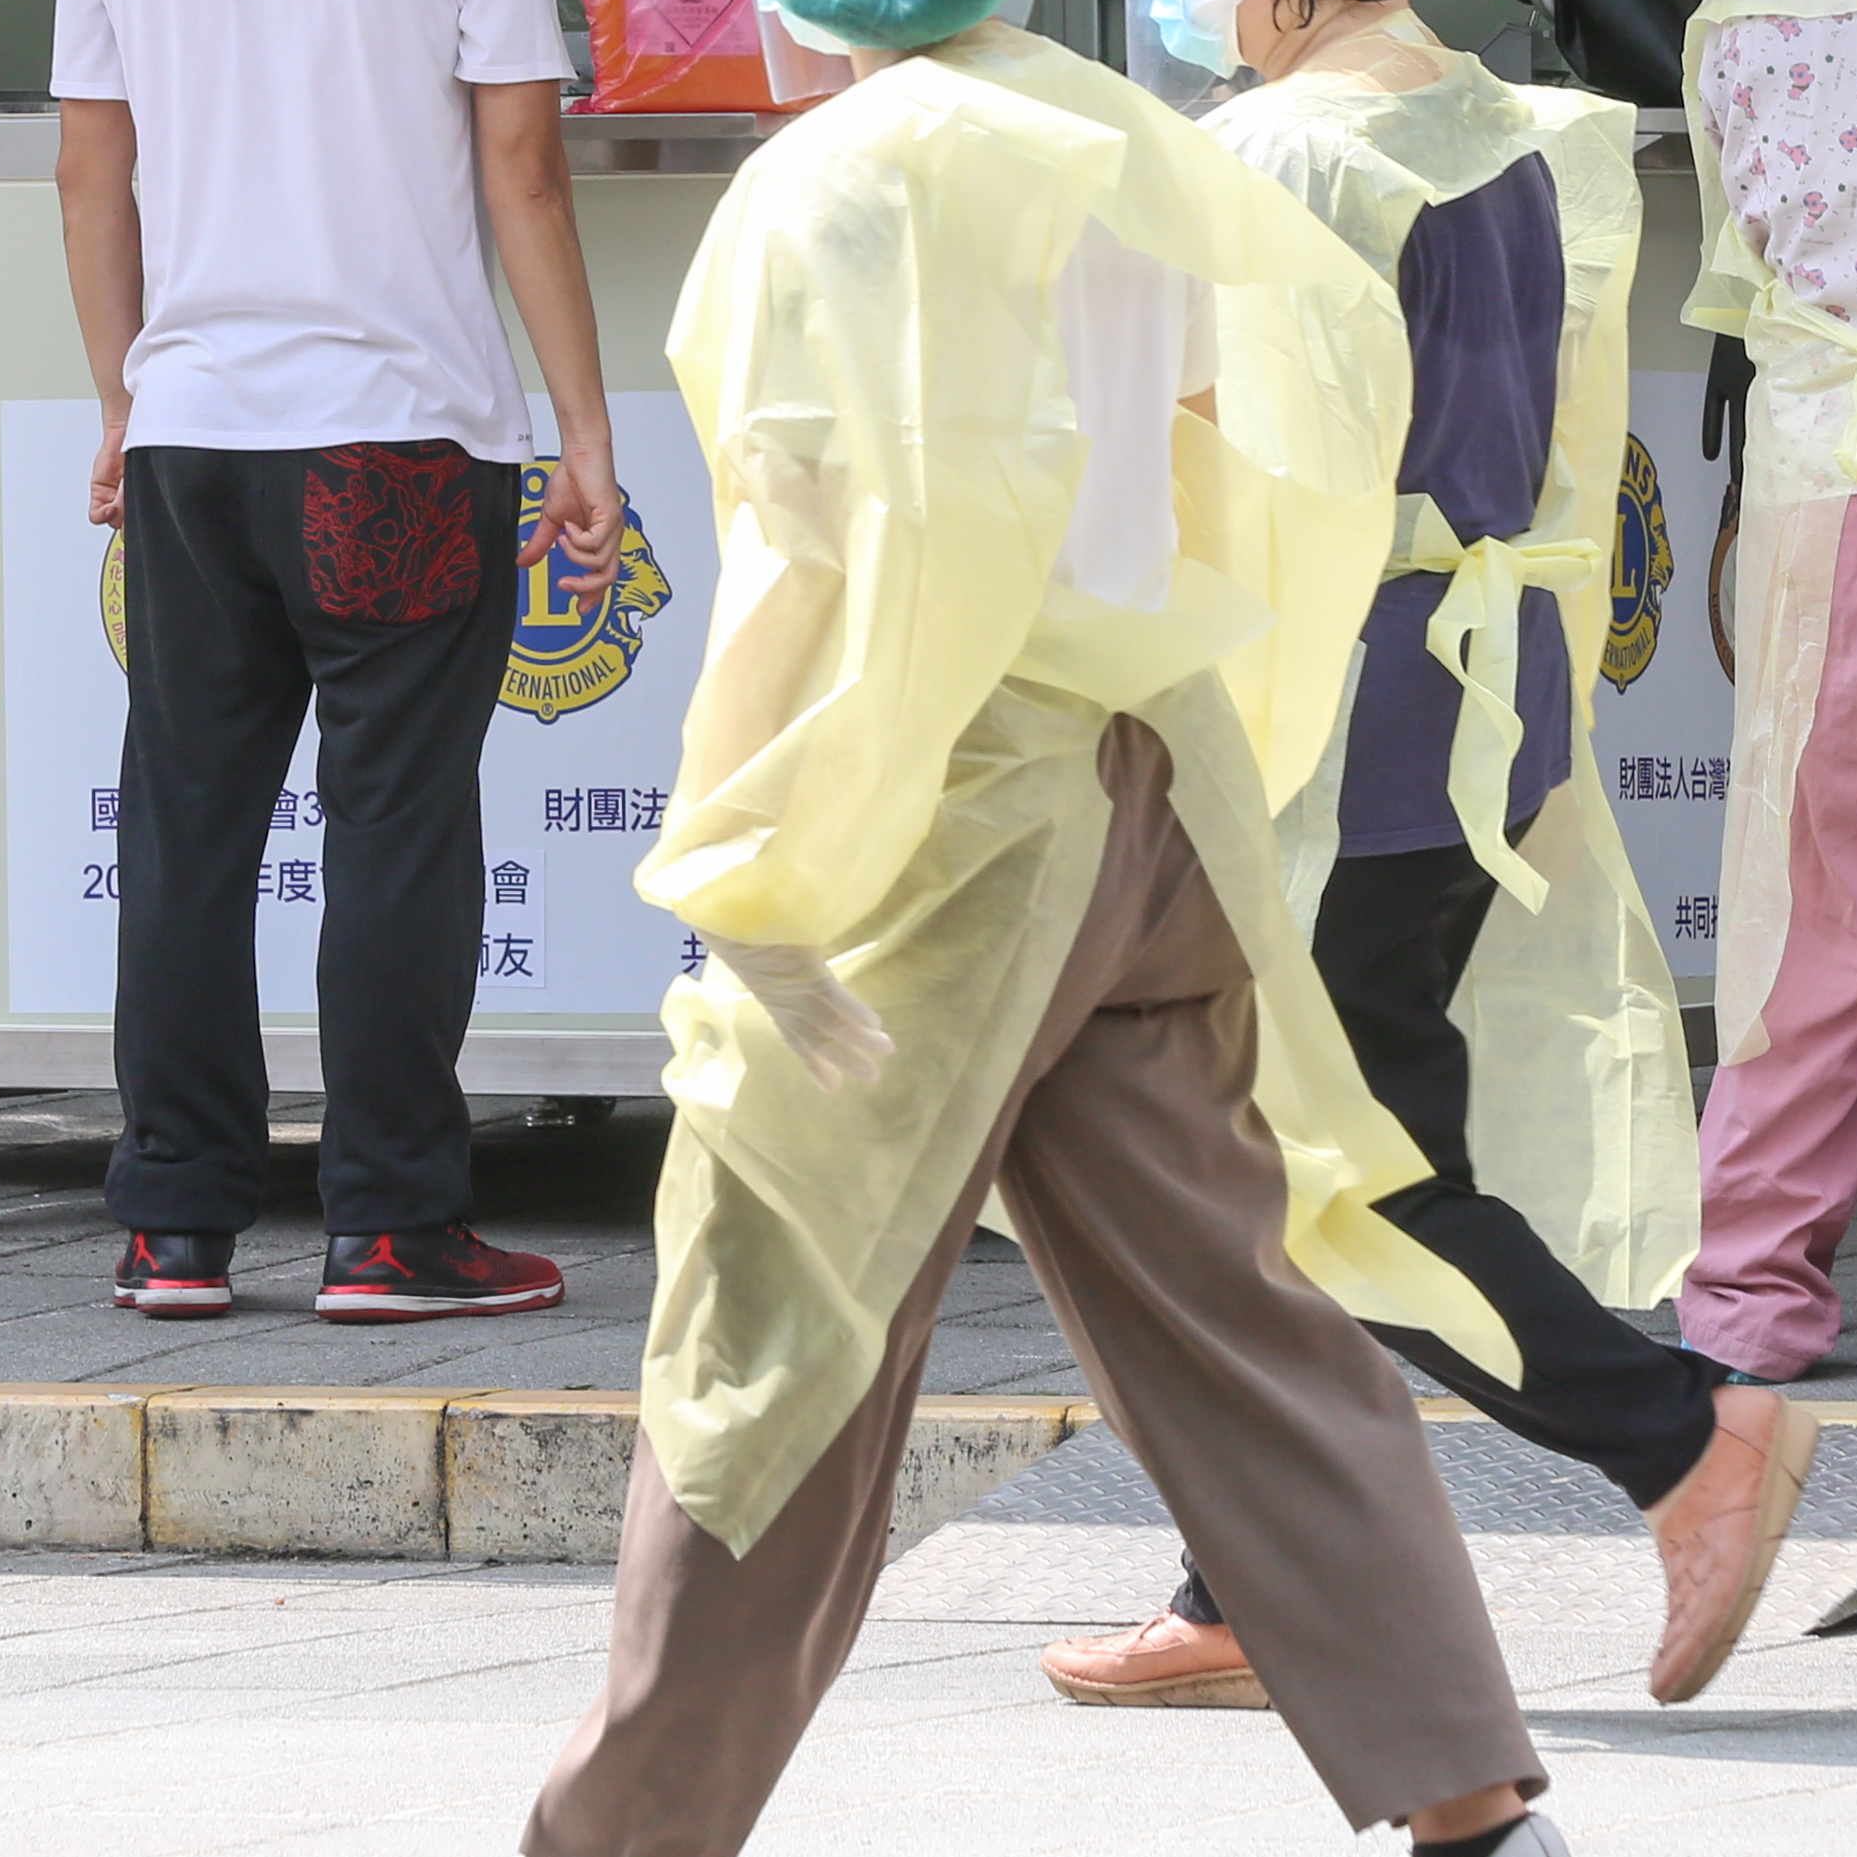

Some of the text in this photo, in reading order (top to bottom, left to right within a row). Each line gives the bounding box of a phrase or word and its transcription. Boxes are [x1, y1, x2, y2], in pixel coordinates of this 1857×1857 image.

[1619, 756, 1731, 801] 財團法人台灣
[544, 787, 668, 832] 財團法
